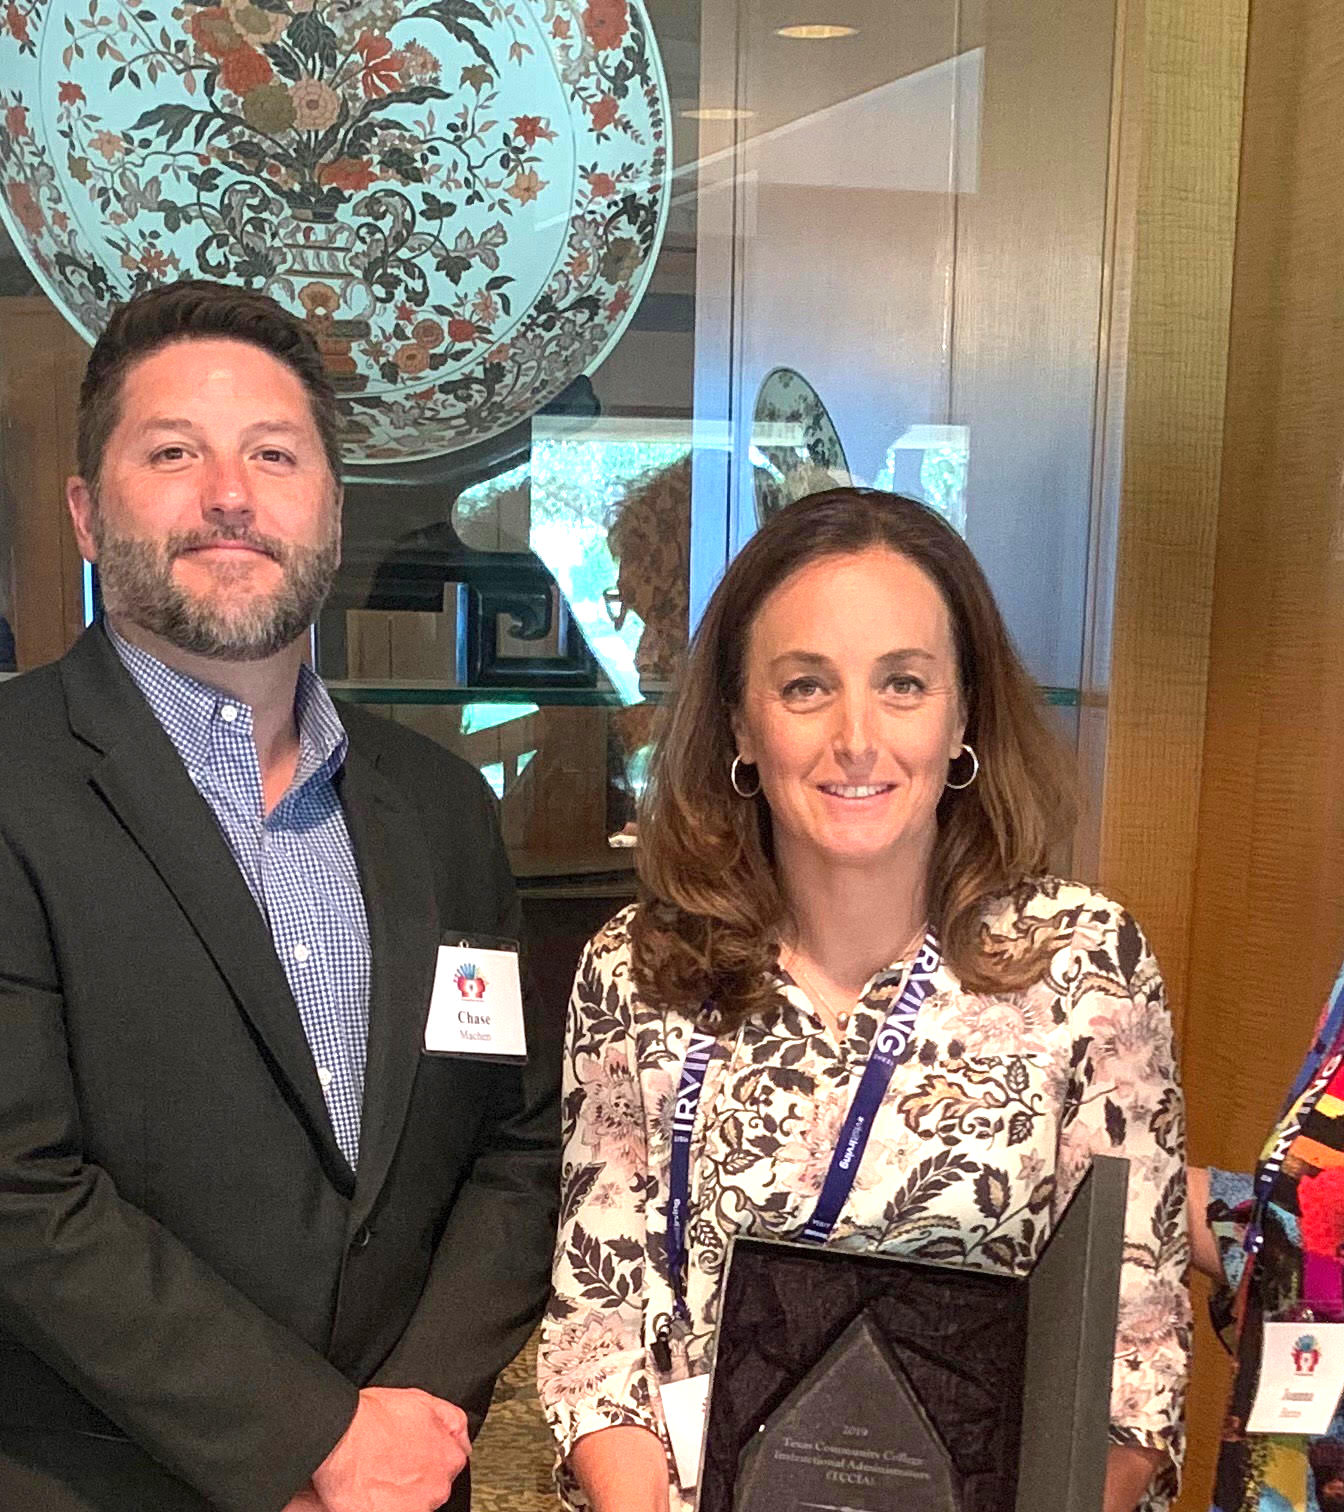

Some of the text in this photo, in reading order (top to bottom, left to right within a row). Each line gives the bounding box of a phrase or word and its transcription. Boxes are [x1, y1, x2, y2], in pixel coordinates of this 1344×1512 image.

[457, 1010, 492, 1025] Chase
[841, 1424, 869, 1437] 2019
[774, 1449, 845, 1469] Instructional
[783, 1436, 926, 1467] Texas Community College
